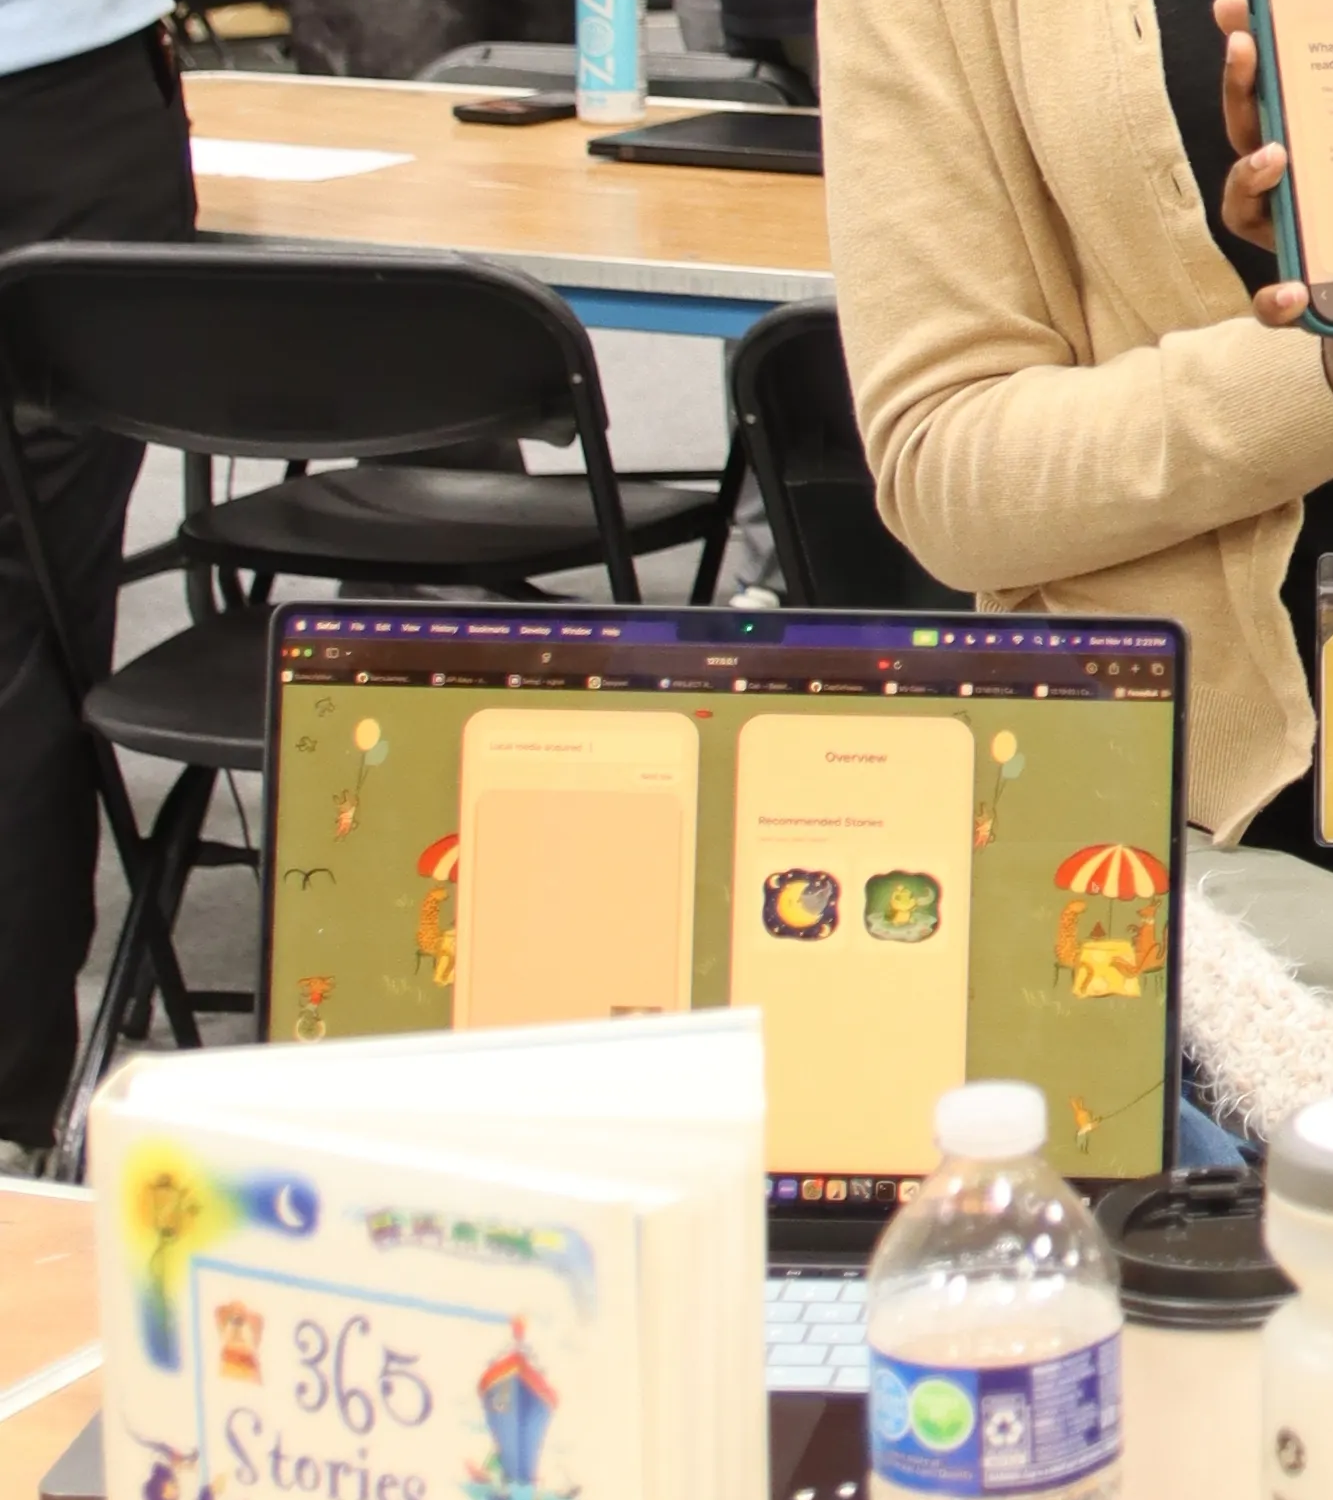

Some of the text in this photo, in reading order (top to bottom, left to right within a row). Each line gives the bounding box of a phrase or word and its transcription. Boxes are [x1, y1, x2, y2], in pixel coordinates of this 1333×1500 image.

[315, 620, 341, 632] Safari
[375, 622, 391, 633] Edit
[401, 623, 421, 633] View
[430, 623, 459, 635] History
[519, 625, 551, 637] Develop
[560, 626, 592, 636] Window
[825, 751, 888, 763] Overview
[758, 816, 885, 828] Recommended Stories
[294, 1314, 434, 1436] 365
